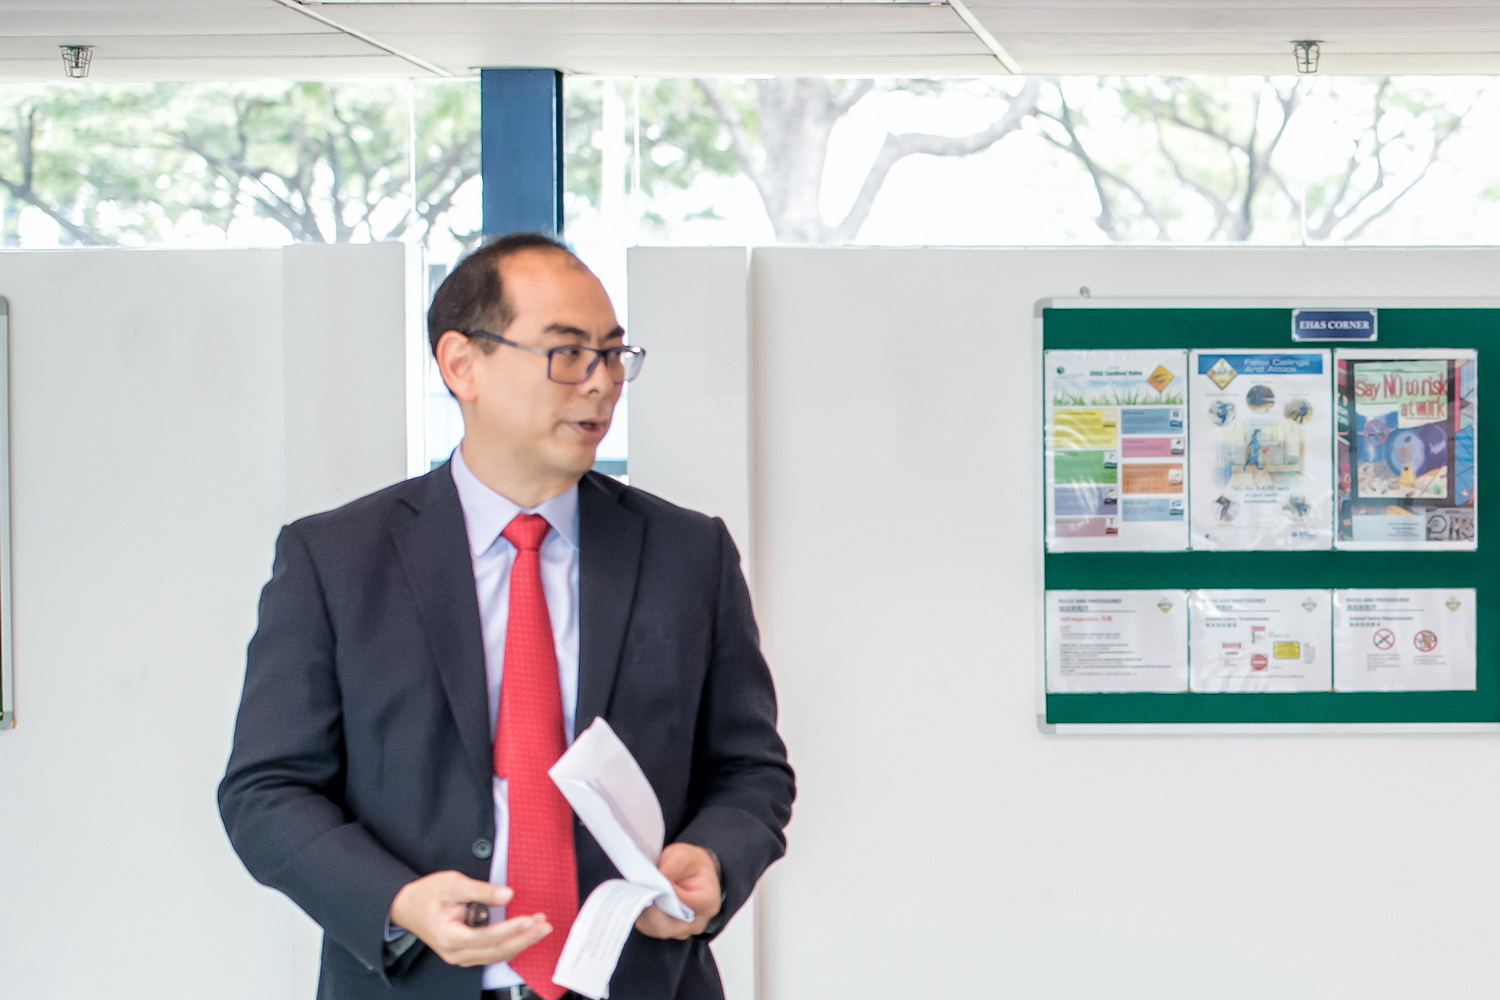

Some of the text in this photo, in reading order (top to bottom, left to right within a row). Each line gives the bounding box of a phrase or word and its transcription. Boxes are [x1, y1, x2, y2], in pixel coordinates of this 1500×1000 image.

[1299, 320, 1370, 330] EH&S CORNER
[1356, 373, 1448, 400] Say NO to risk
[1400, 396, 1446, 416] at work
